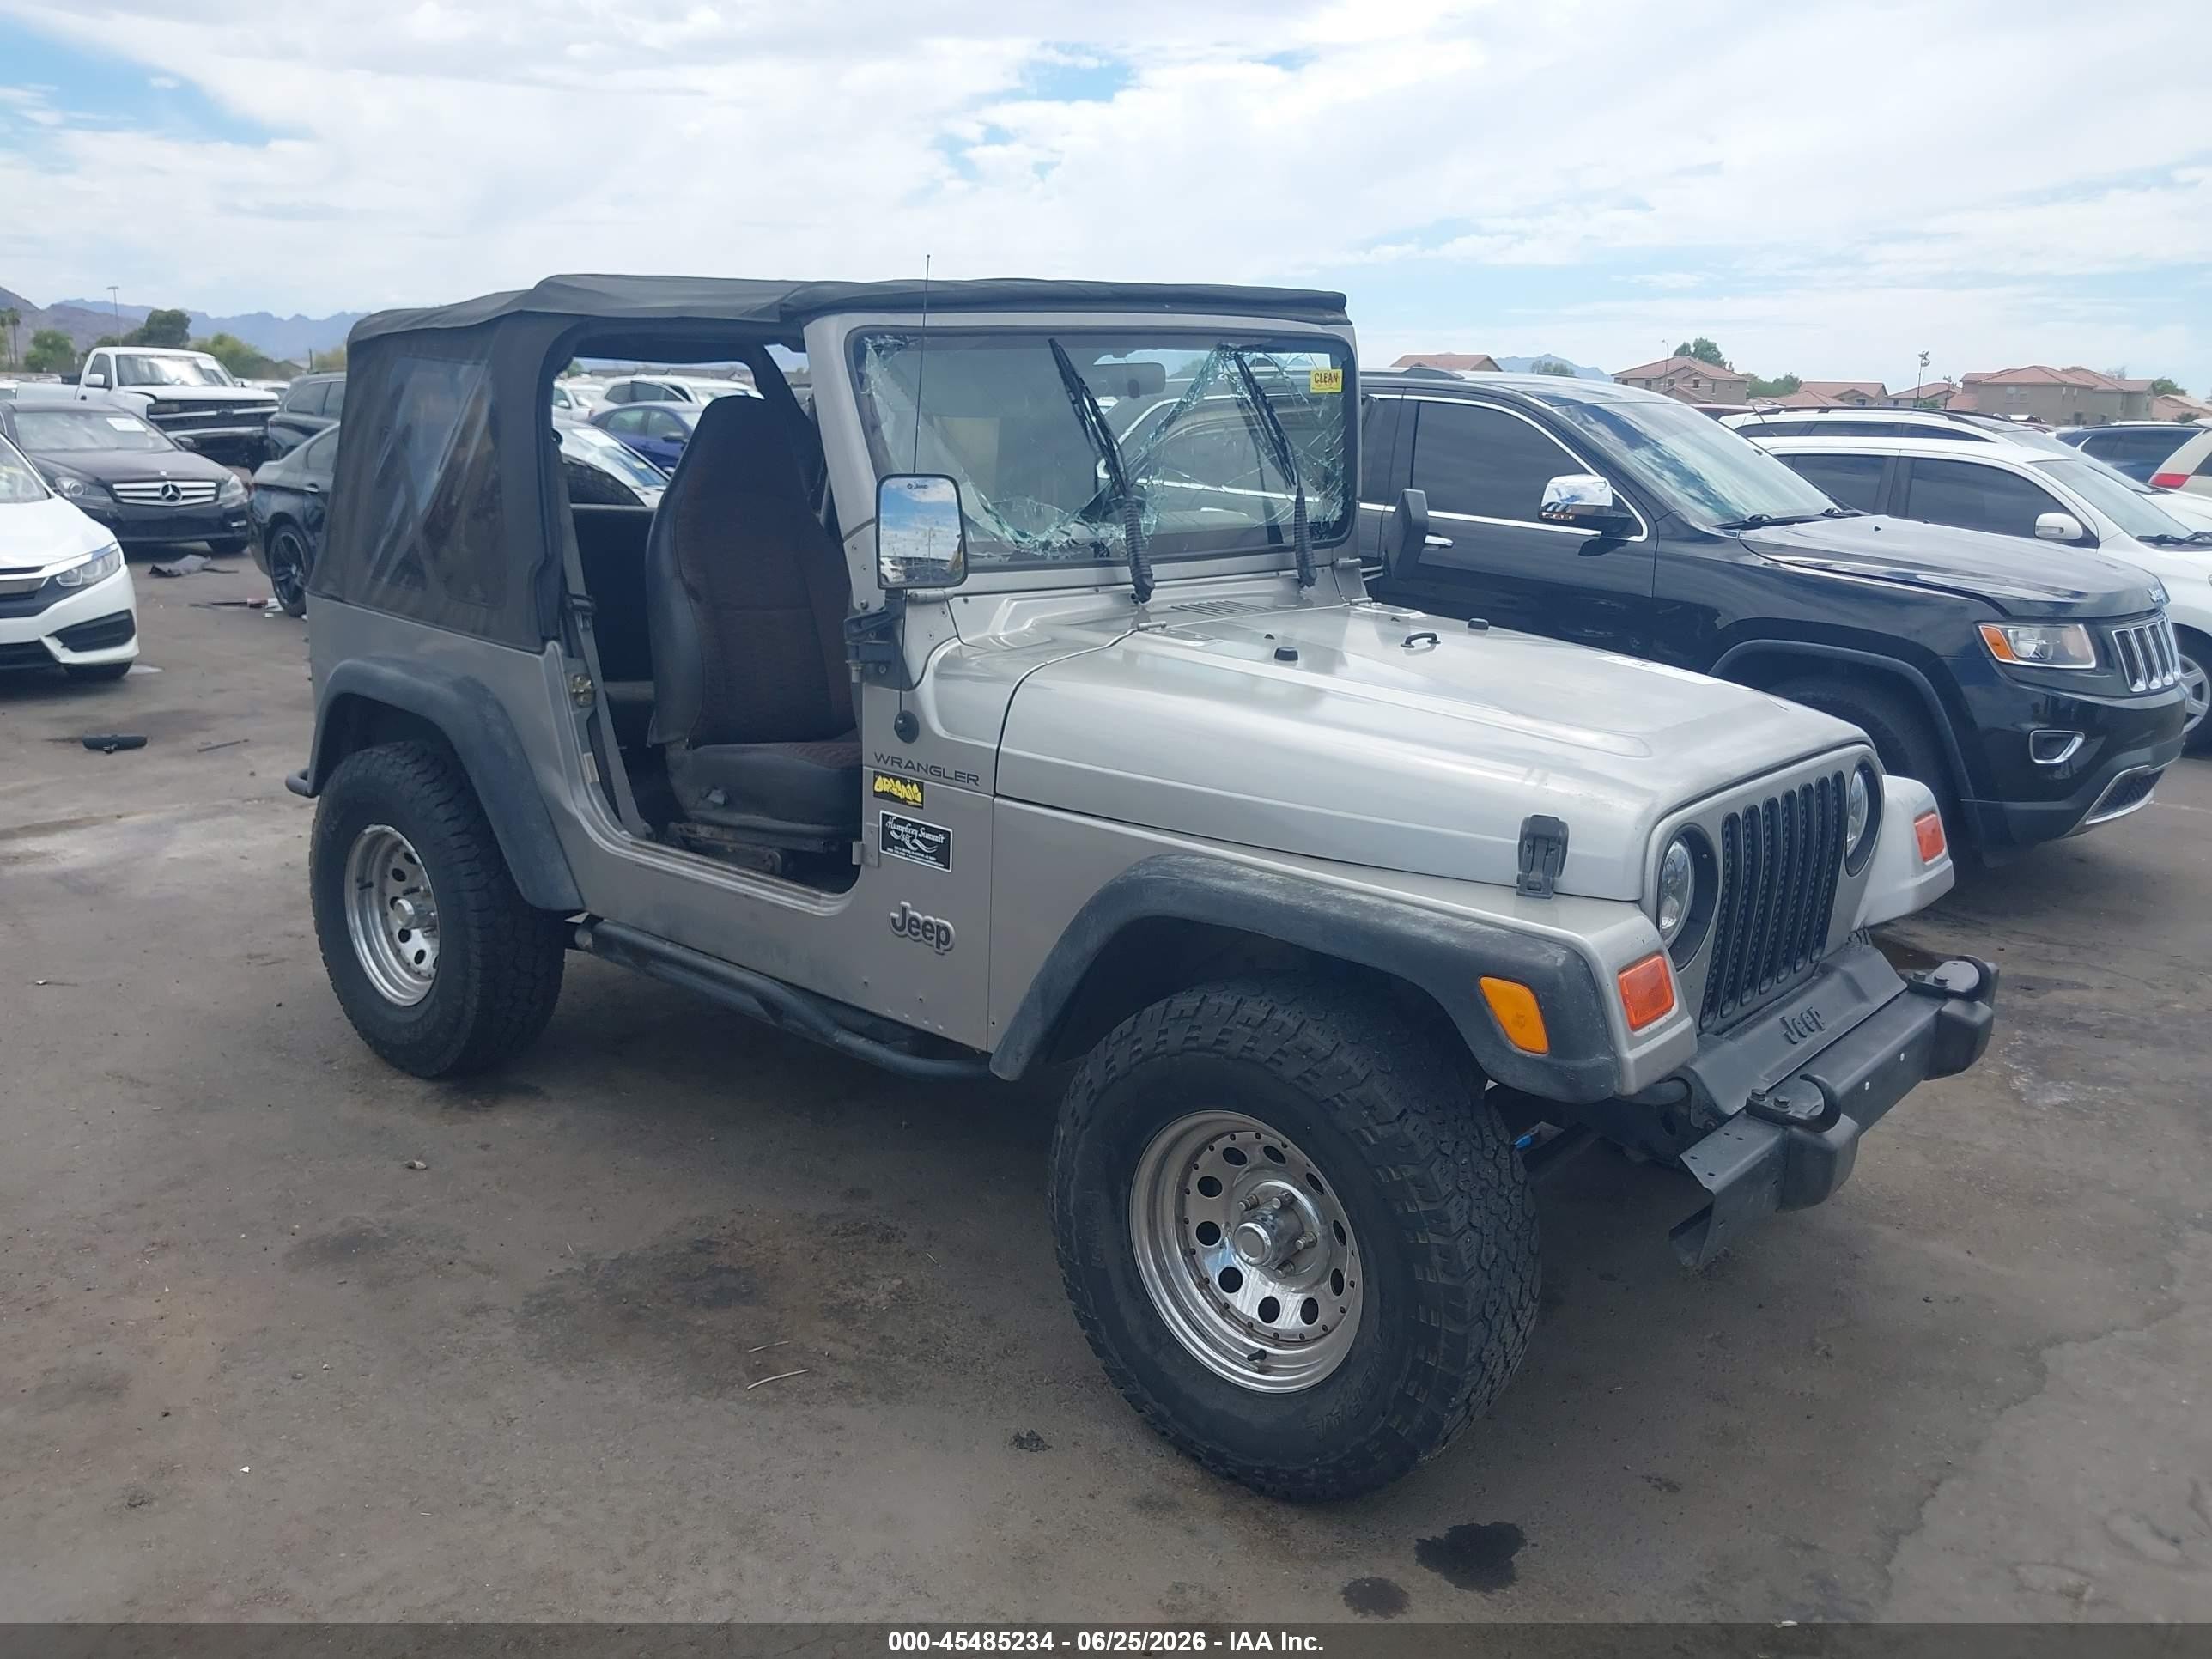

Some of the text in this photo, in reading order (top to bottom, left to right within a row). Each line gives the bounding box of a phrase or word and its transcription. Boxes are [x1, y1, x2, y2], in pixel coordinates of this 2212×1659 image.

[1314, 373, 1339, 384] CLEAN
[873, 751, 980, 786] WRANGLER
[918, 827, 945, 843] Summit
[890, 901, 955, 954] Jeep
[1778, 1006, 1826, 1045] Jeep
